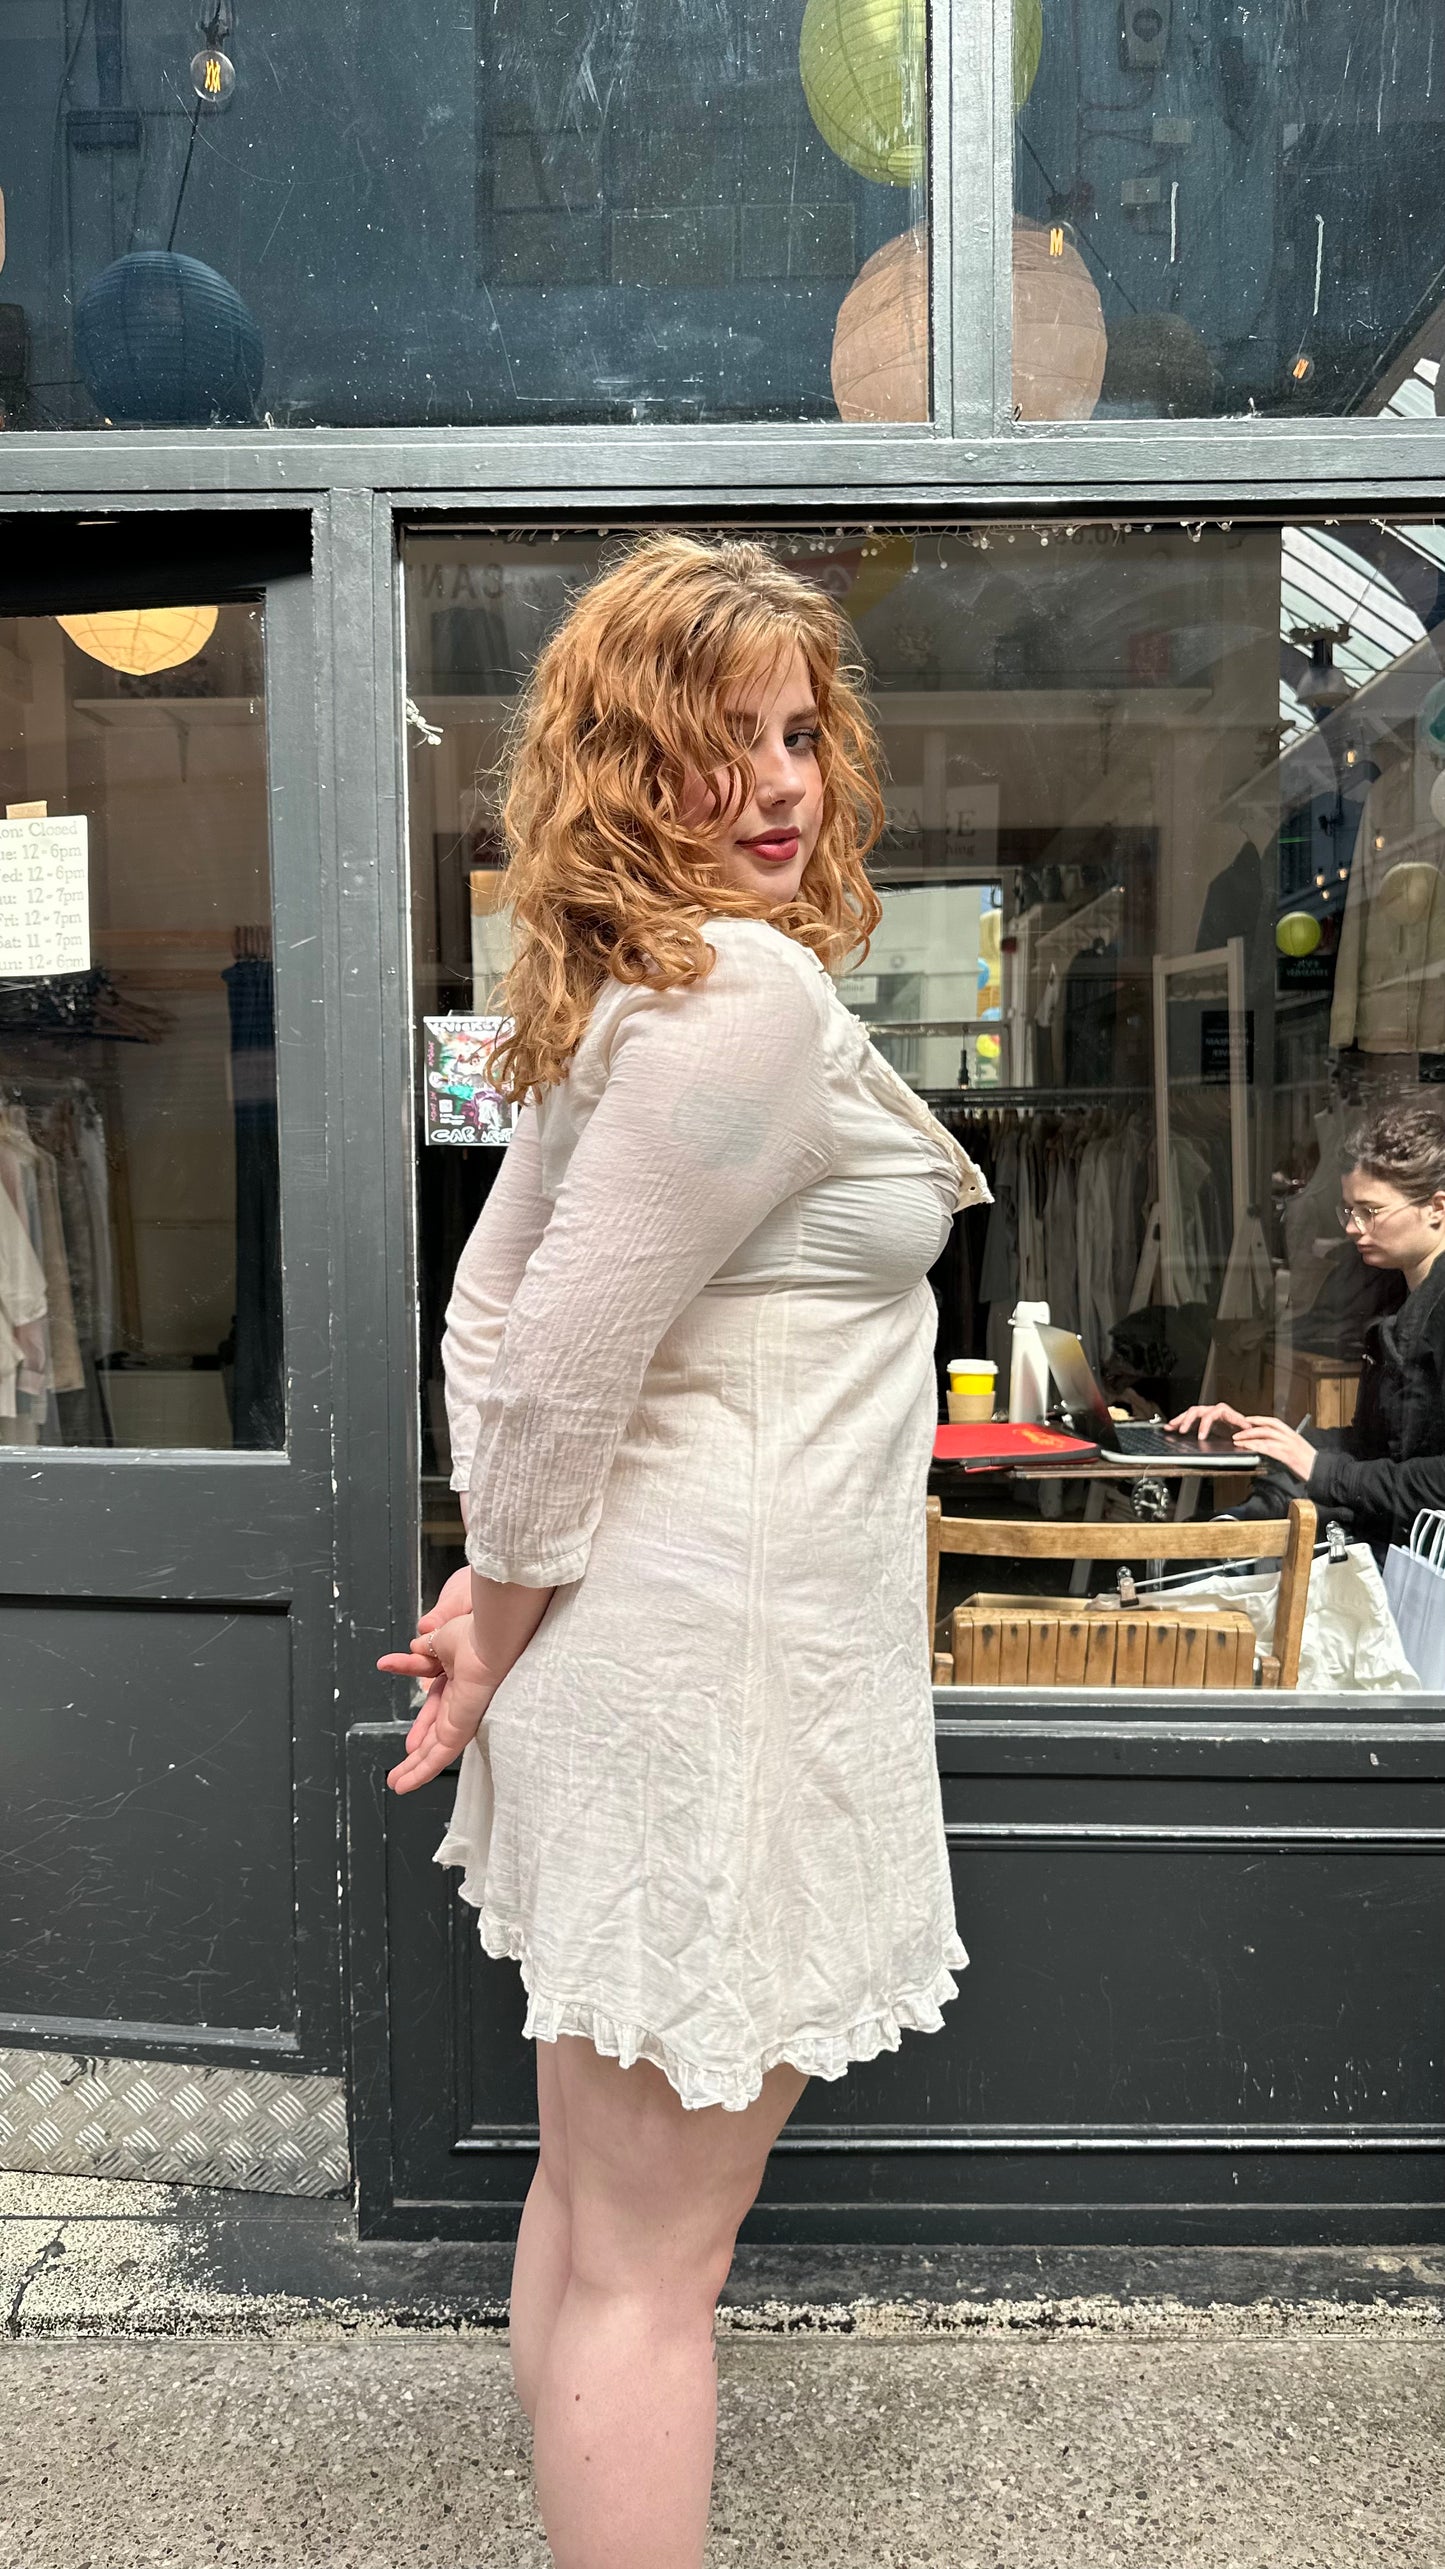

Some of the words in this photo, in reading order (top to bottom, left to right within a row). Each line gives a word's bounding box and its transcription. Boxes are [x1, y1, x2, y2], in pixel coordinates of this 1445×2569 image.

[0, 827, 23, 839] on:
[28, 820, 78, 837] Closed
[22, 843, 40, 860] 12
[50, 843, 82, 862] 6pm
[0, 868, 23, 883] ed:
[27, 866, 44, 881] 12
[55, 865, 85, 884] 6pm
[27, 887, 44, 904] 12
[56, 887, 84, 906] 7pm
[24, 909, 41, 926] 12
[53, 910, 82, 928] 7pm
[26, 933, 40, 948] 11
[55, 932, 82, 950] 7pm
[0, 960, 23, 970] un:
[28, 954, 45, 969] 12
